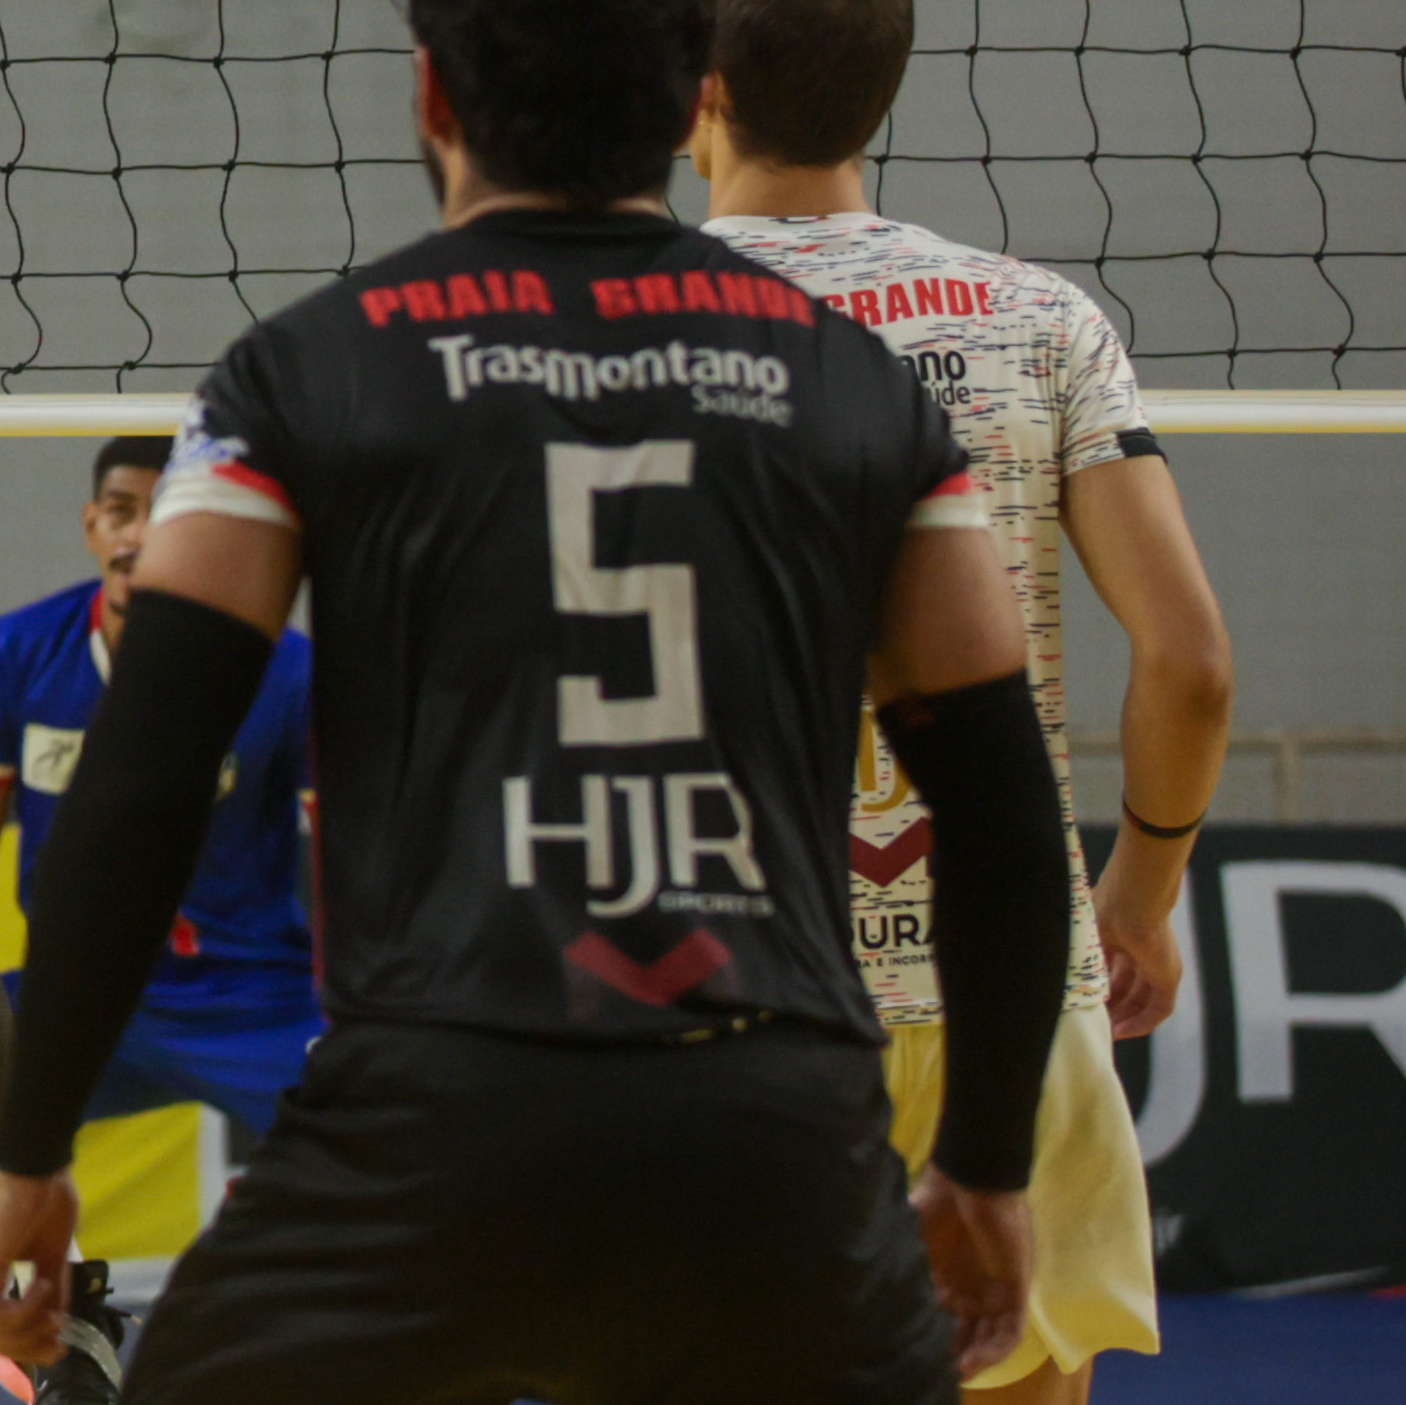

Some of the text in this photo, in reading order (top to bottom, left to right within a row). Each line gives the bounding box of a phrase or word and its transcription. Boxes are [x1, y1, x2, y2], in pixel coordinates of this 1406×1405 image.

[359, 270, 554, 328] PRAIA
[428, 335, 789, 402] Trasmontano
[544, 440, 705, 747] 5
[503, 772, 767, 918] HJR
